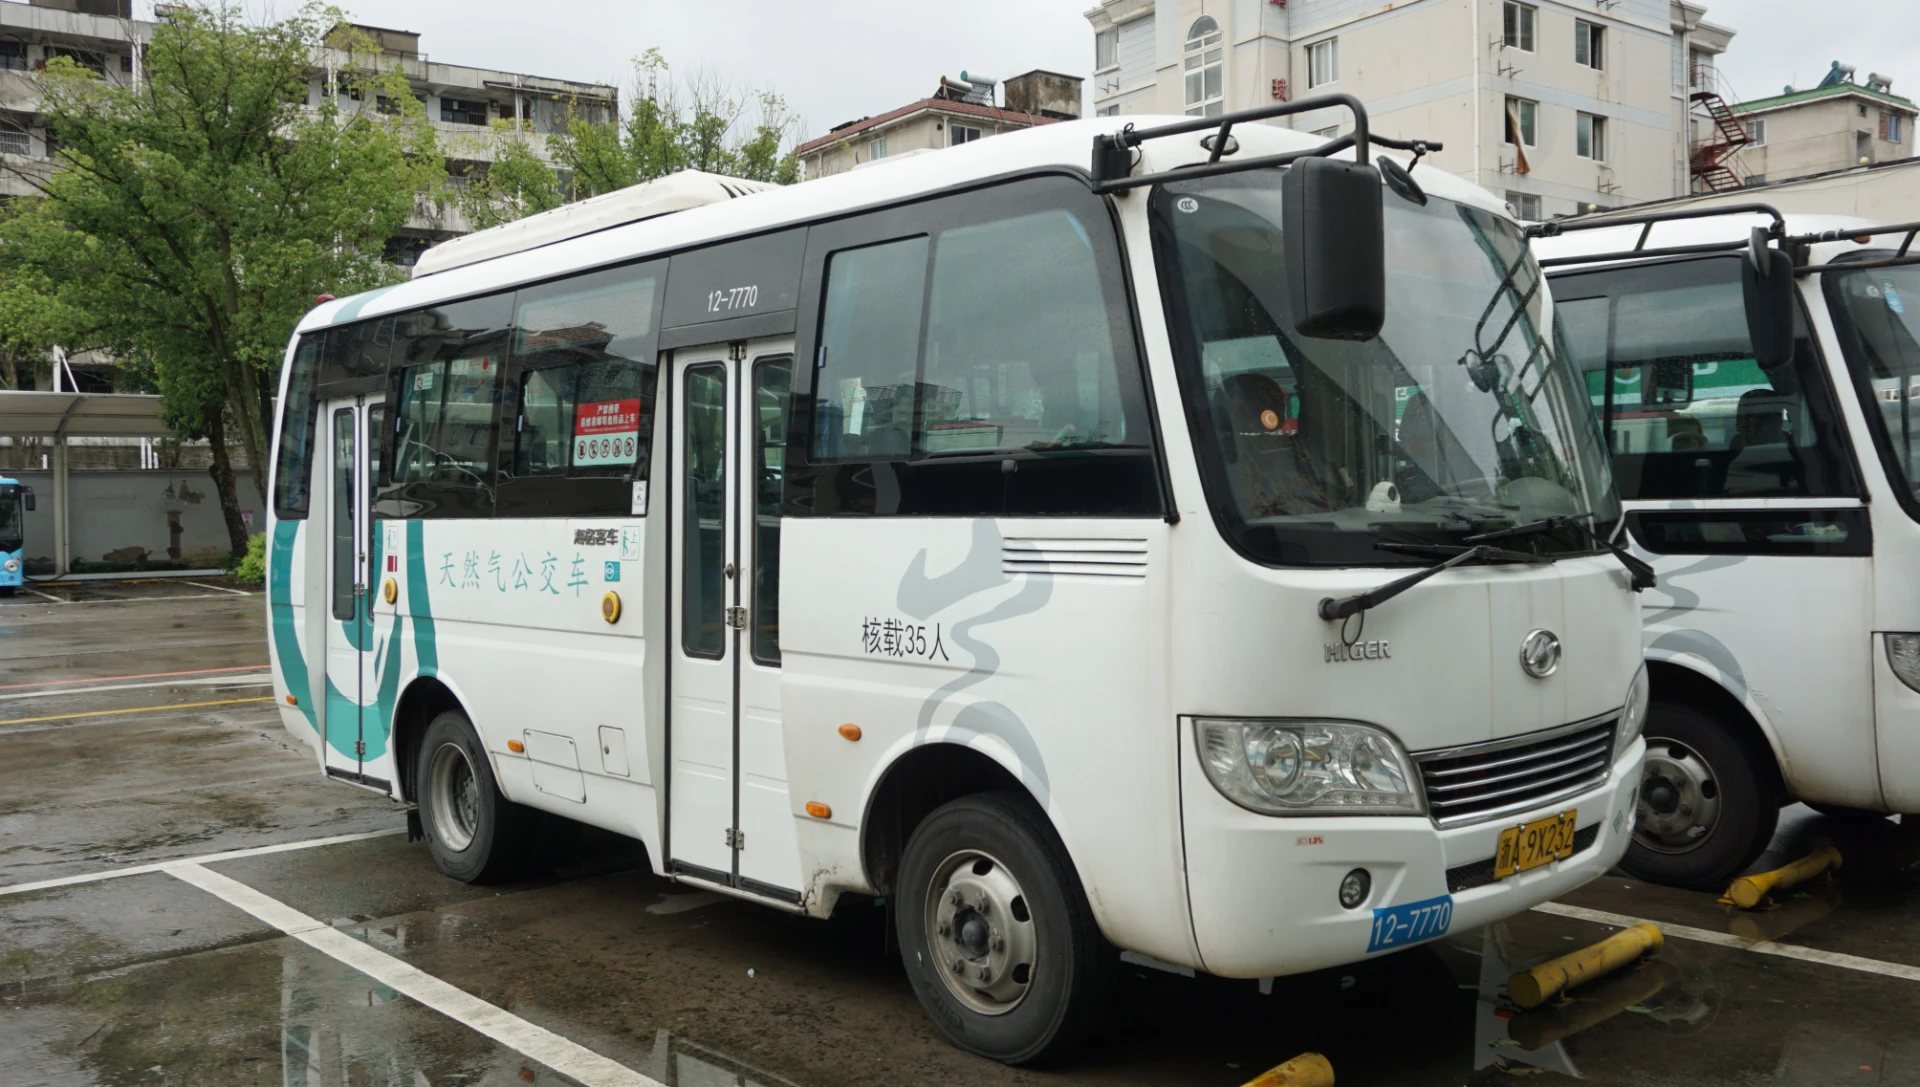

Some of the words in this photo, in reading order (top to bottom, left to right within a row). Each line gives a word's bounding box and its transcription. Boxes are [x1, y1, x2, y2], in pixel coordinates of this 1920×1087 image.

[708, 285, 758, 312] 12-7770
[439, 550, 589, 598] 天然气公交车
[862, 616, 950, 662] 核载35人
[1324, 640, 1392, 663] HIGER
[1375, 901, 1451, 946] 12-7770
